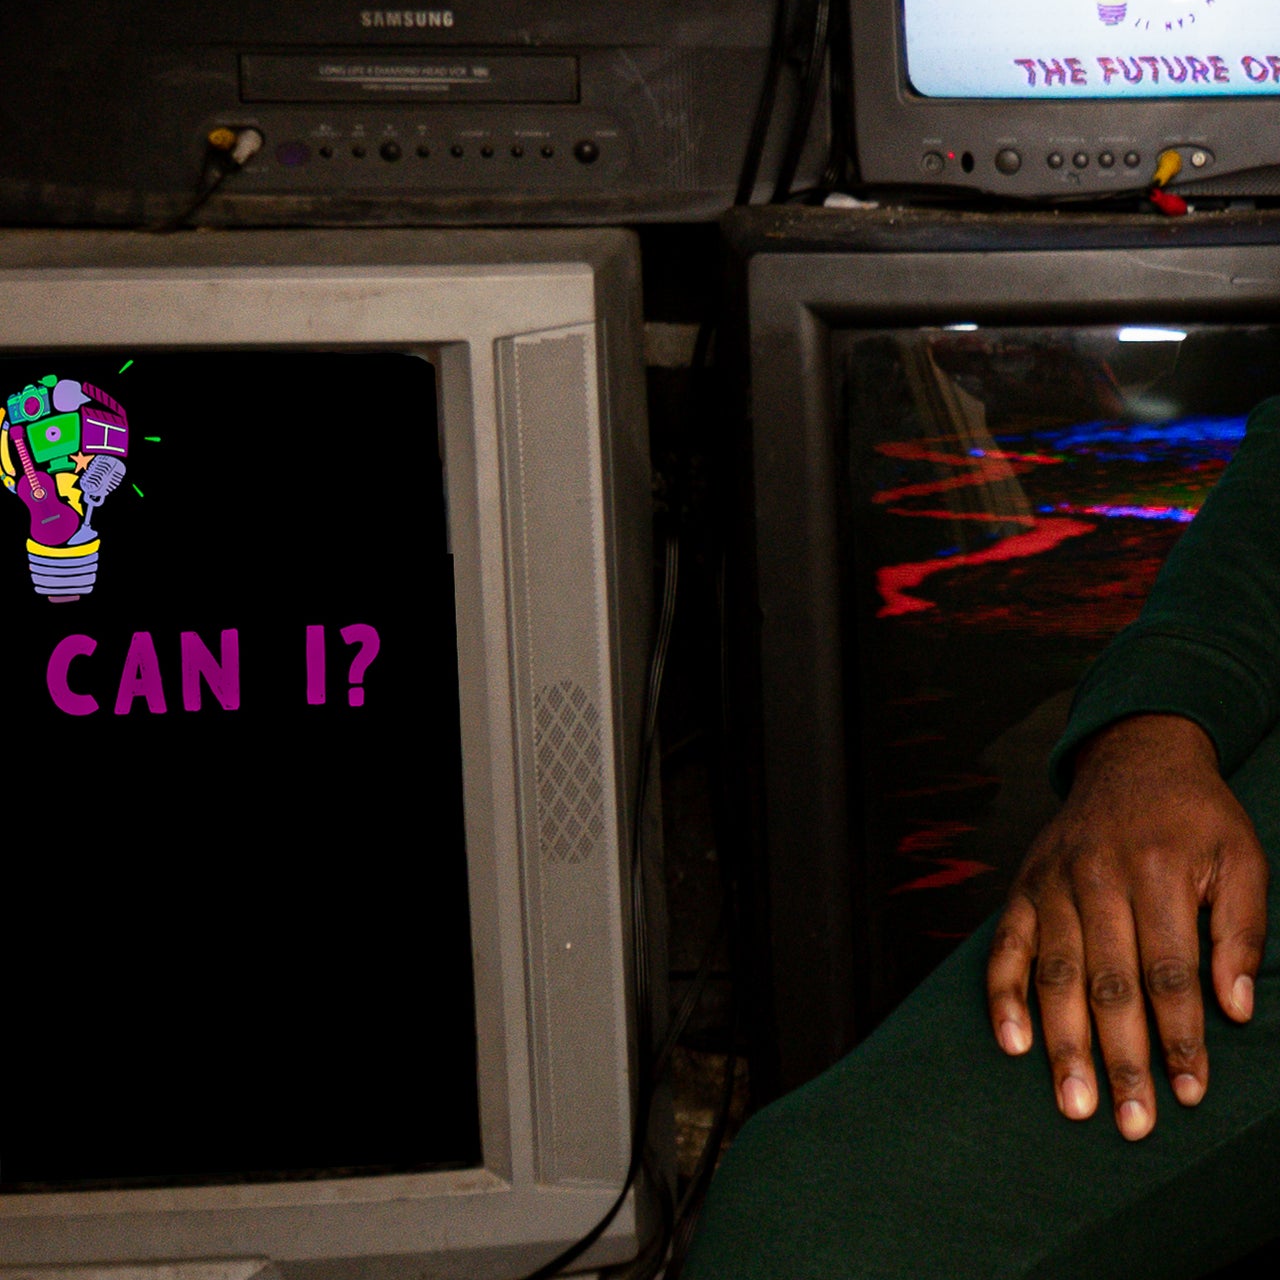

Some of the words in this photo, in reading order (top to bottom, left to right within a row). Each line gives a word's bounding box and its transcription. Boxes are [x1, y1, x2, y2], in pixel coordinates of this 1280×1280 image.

[361, 10, 455, 28] SAMSUNG
[1014, 56, 1088, 87] THE
[1096, 55, 1231, 85] FUTURE
[47, 629, 241, 716] CAN
[305, 623, 381, 707] I?
